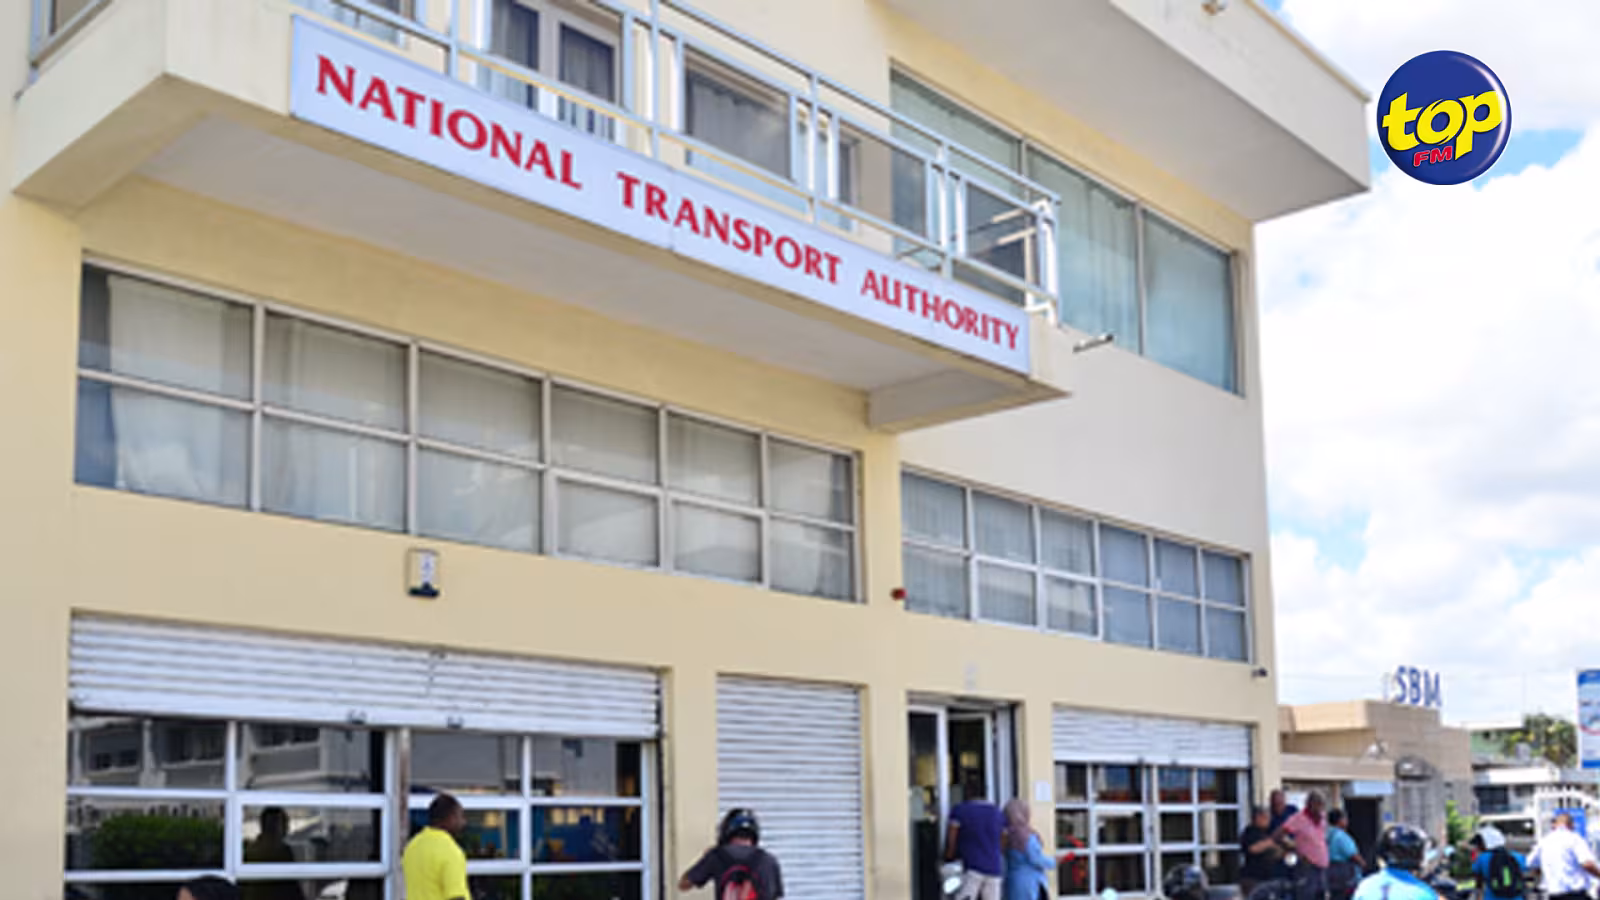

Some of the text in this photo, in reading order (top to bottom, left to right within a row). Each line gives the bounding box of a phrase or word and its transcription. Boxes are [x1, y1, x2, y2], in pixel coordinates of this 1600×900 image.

[317, 55, 1019, 349] NATIONAL TRANSPORT AUTHORITY
[1396, 665, 1441, 706] SBM
